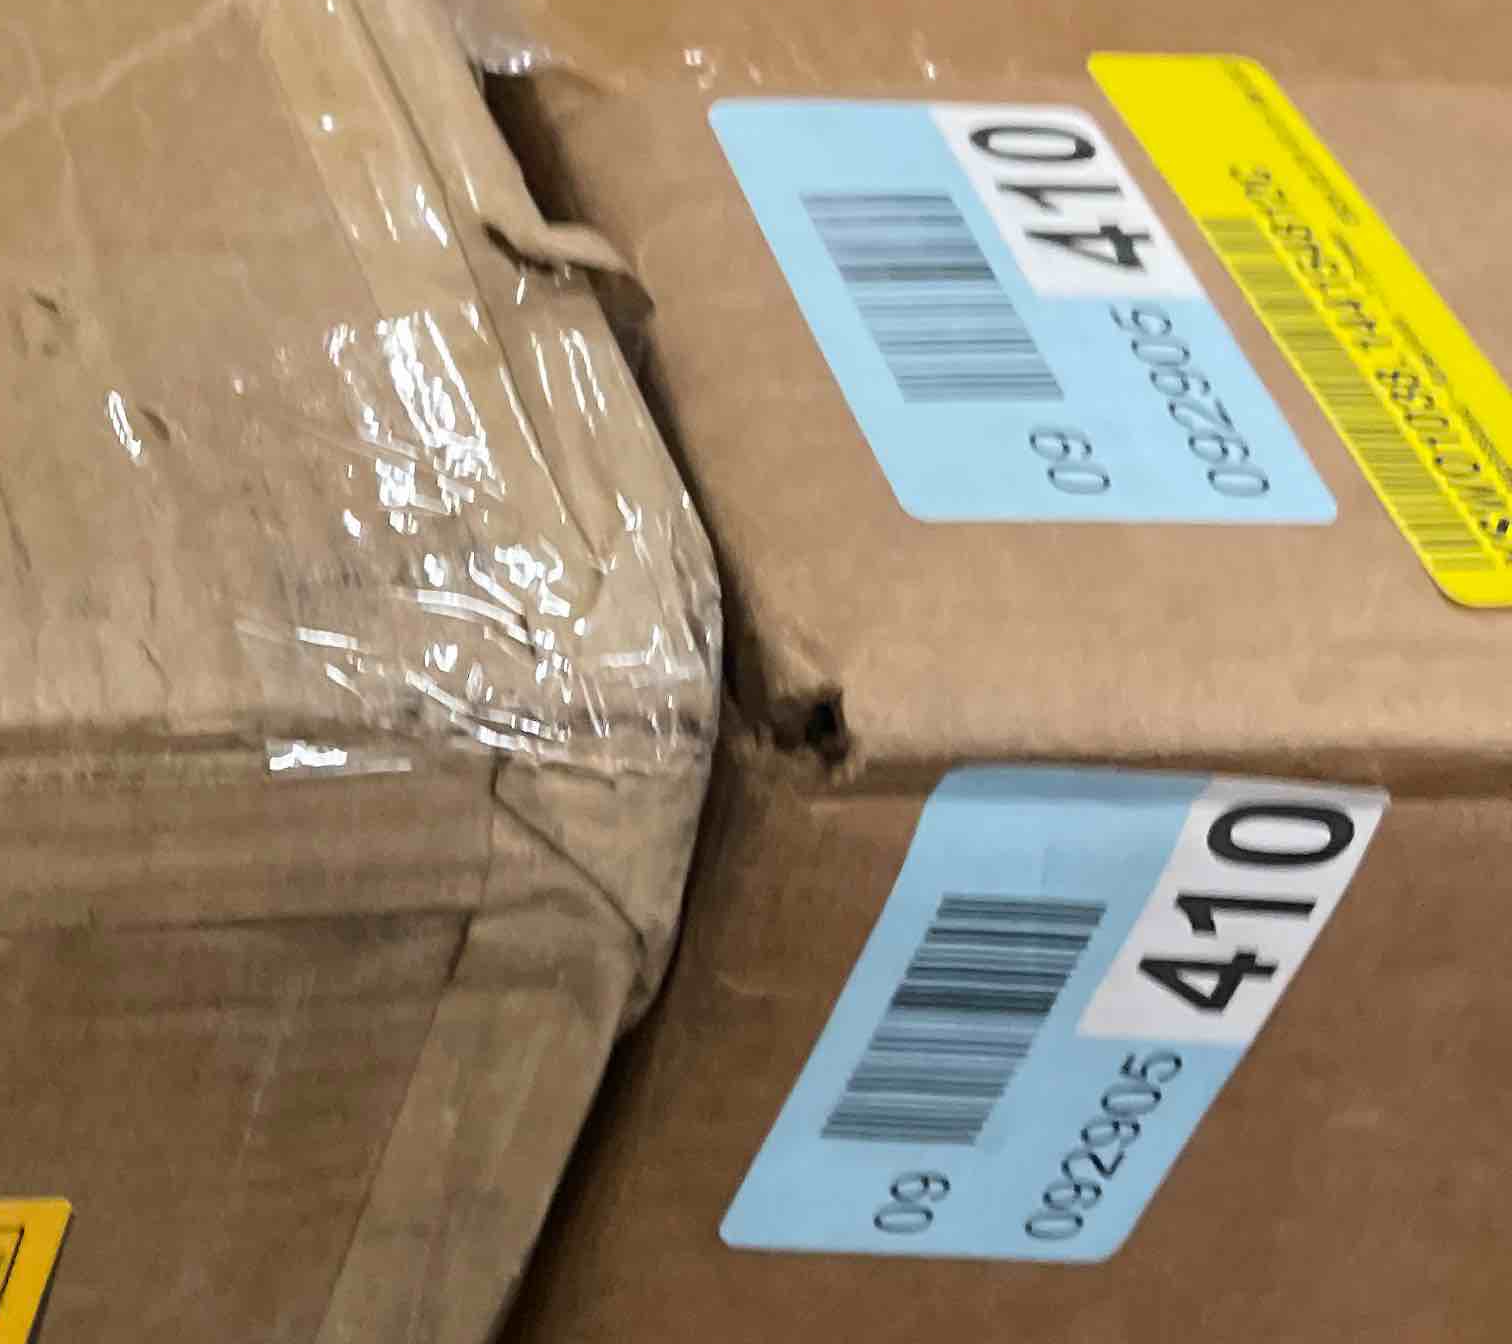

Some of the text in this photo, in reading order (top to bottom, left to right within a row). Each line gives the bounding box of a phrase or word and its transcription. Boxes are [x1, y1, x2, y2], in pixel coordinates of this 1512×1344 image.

[968, 121, 1153, 273] 410
[1028, 425, 1111, 496] 09
[1109, 304, 1270, 499] 092905
[1137, 802, 1355, 1015] 410
[873, 1170, 951, 1235] 09
[1024, 1051, 1183, 1241] 092905
